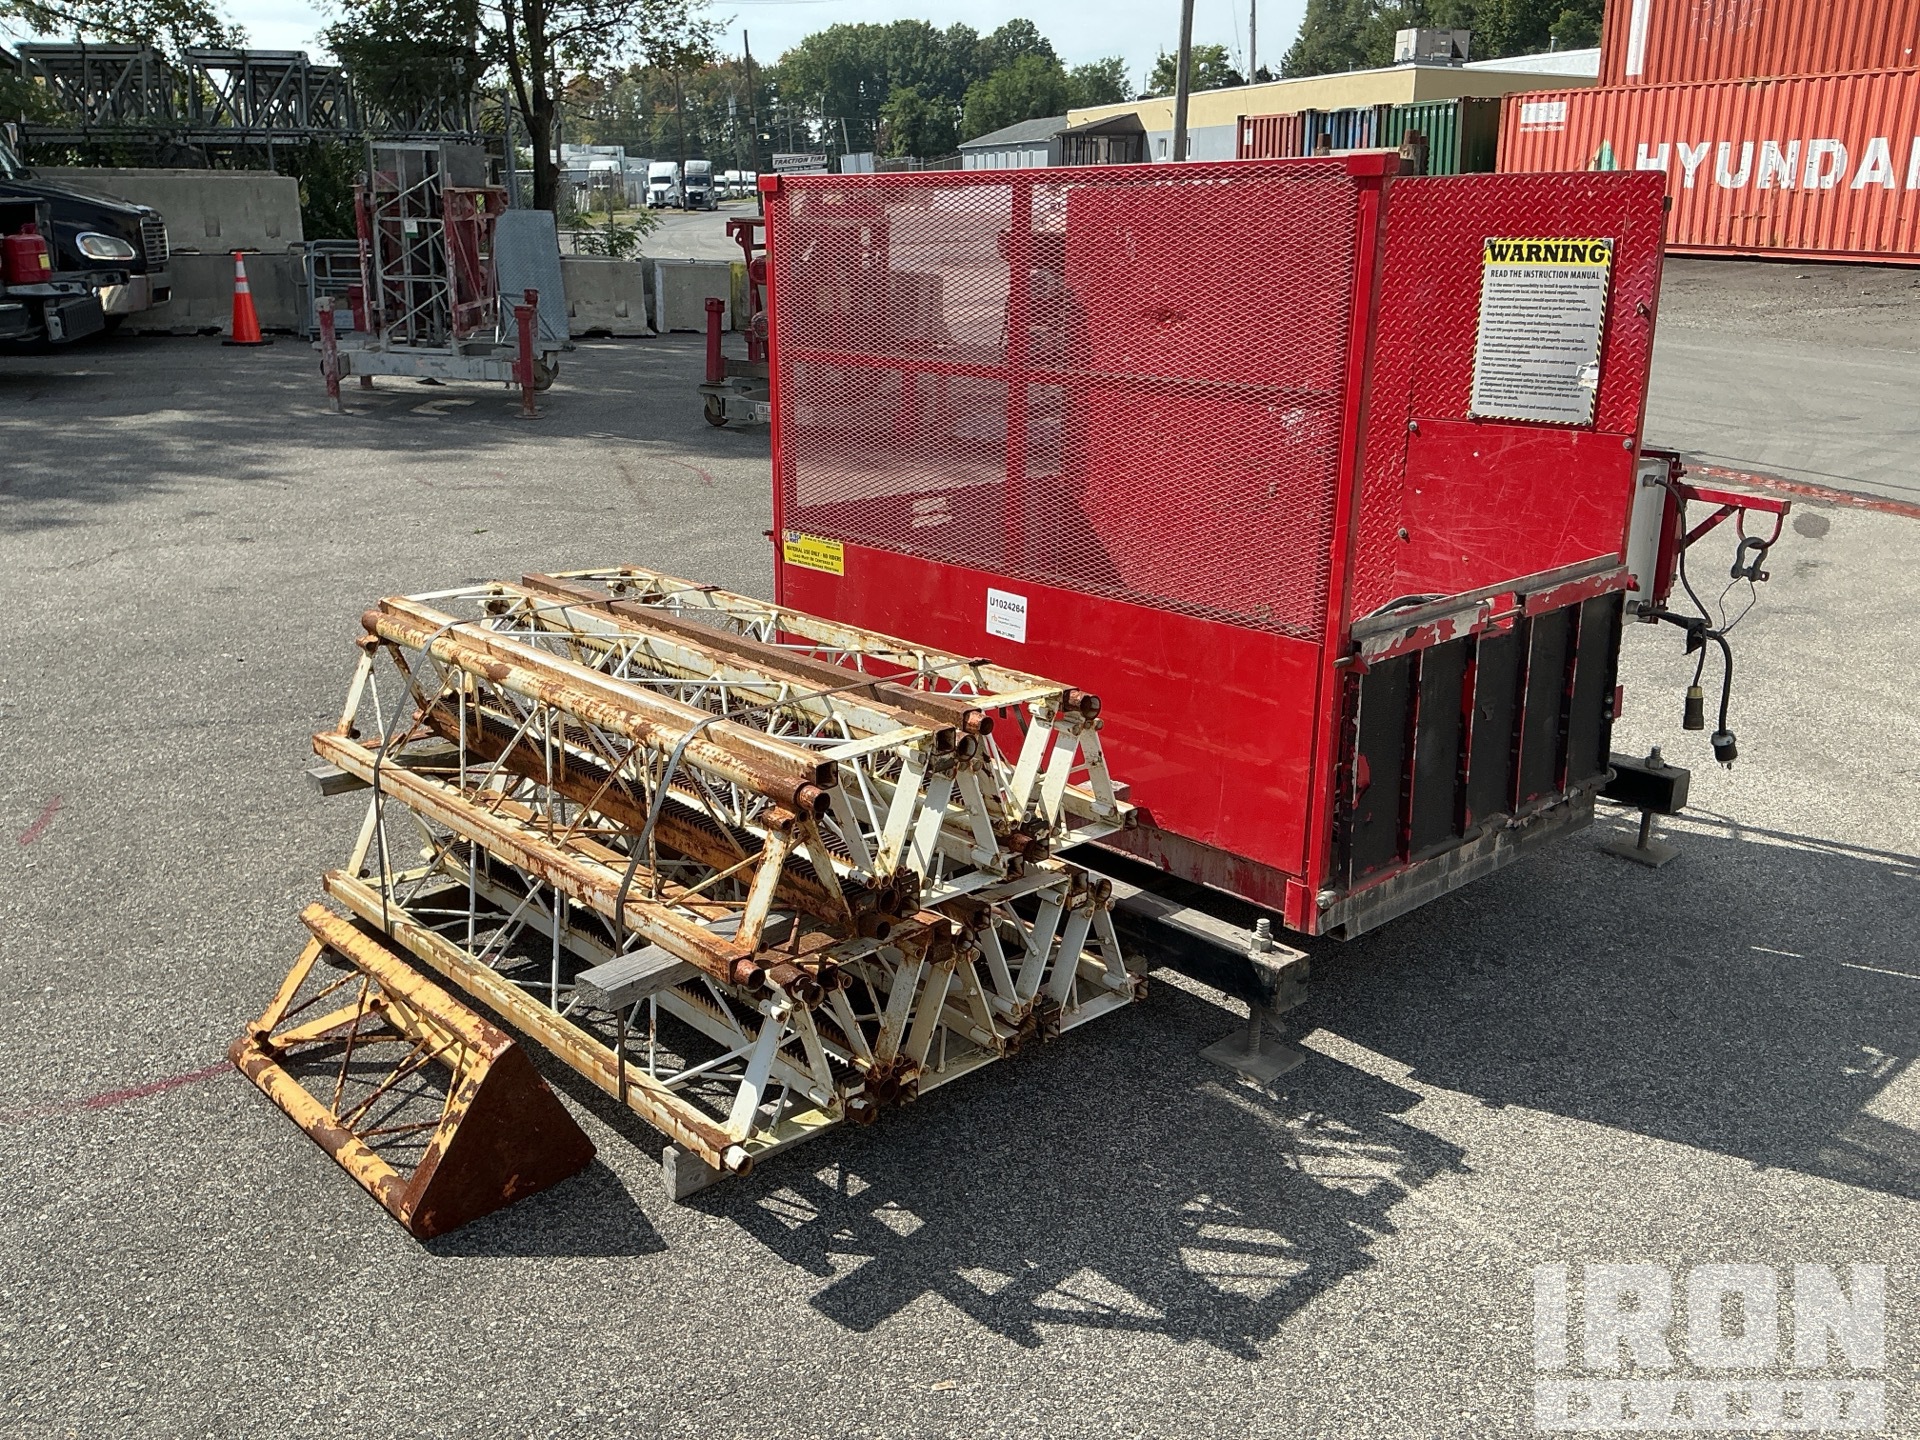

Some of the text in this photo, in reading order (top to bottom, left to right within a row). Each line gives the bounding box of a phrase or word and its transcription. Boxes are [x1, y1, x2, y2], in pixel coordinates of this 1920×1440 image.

[774, 158, 809, 166] TRACTION
[1489, 244, 1606, 263] WARNING
[1490, 269, 1601, 280] READ THE INSTRUCTION MANUAL
[990, 597, 1024, 613] U1024264
